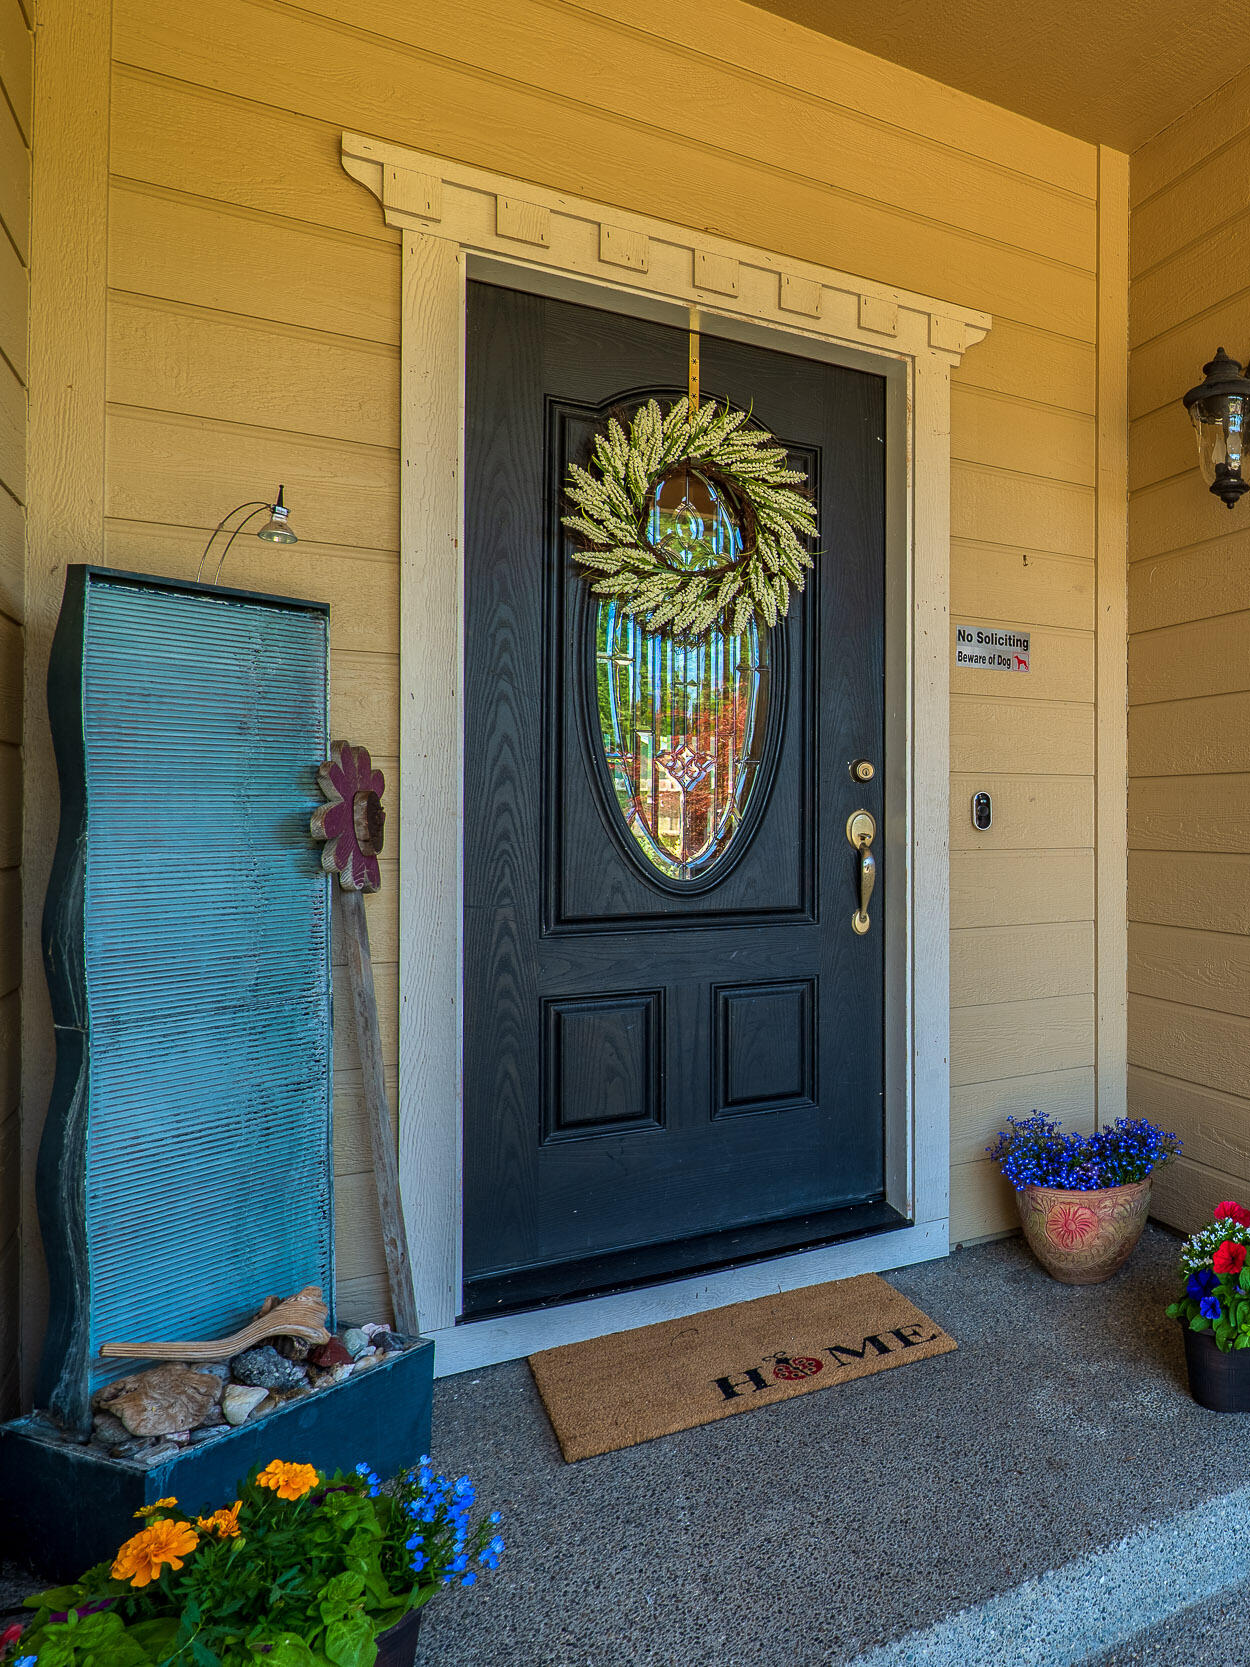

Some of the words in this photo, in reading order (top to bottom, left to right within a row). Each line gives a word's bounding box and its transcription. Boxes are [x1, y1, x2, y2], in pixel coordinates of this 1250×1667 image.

[957, 629, 973, 643] No
[976, 631, 1029, 651] Soliciting
[957, 651, 986, 664] Beware
[988, 654, 996, 665] of
[997, 654, 1011, 669] Dog
